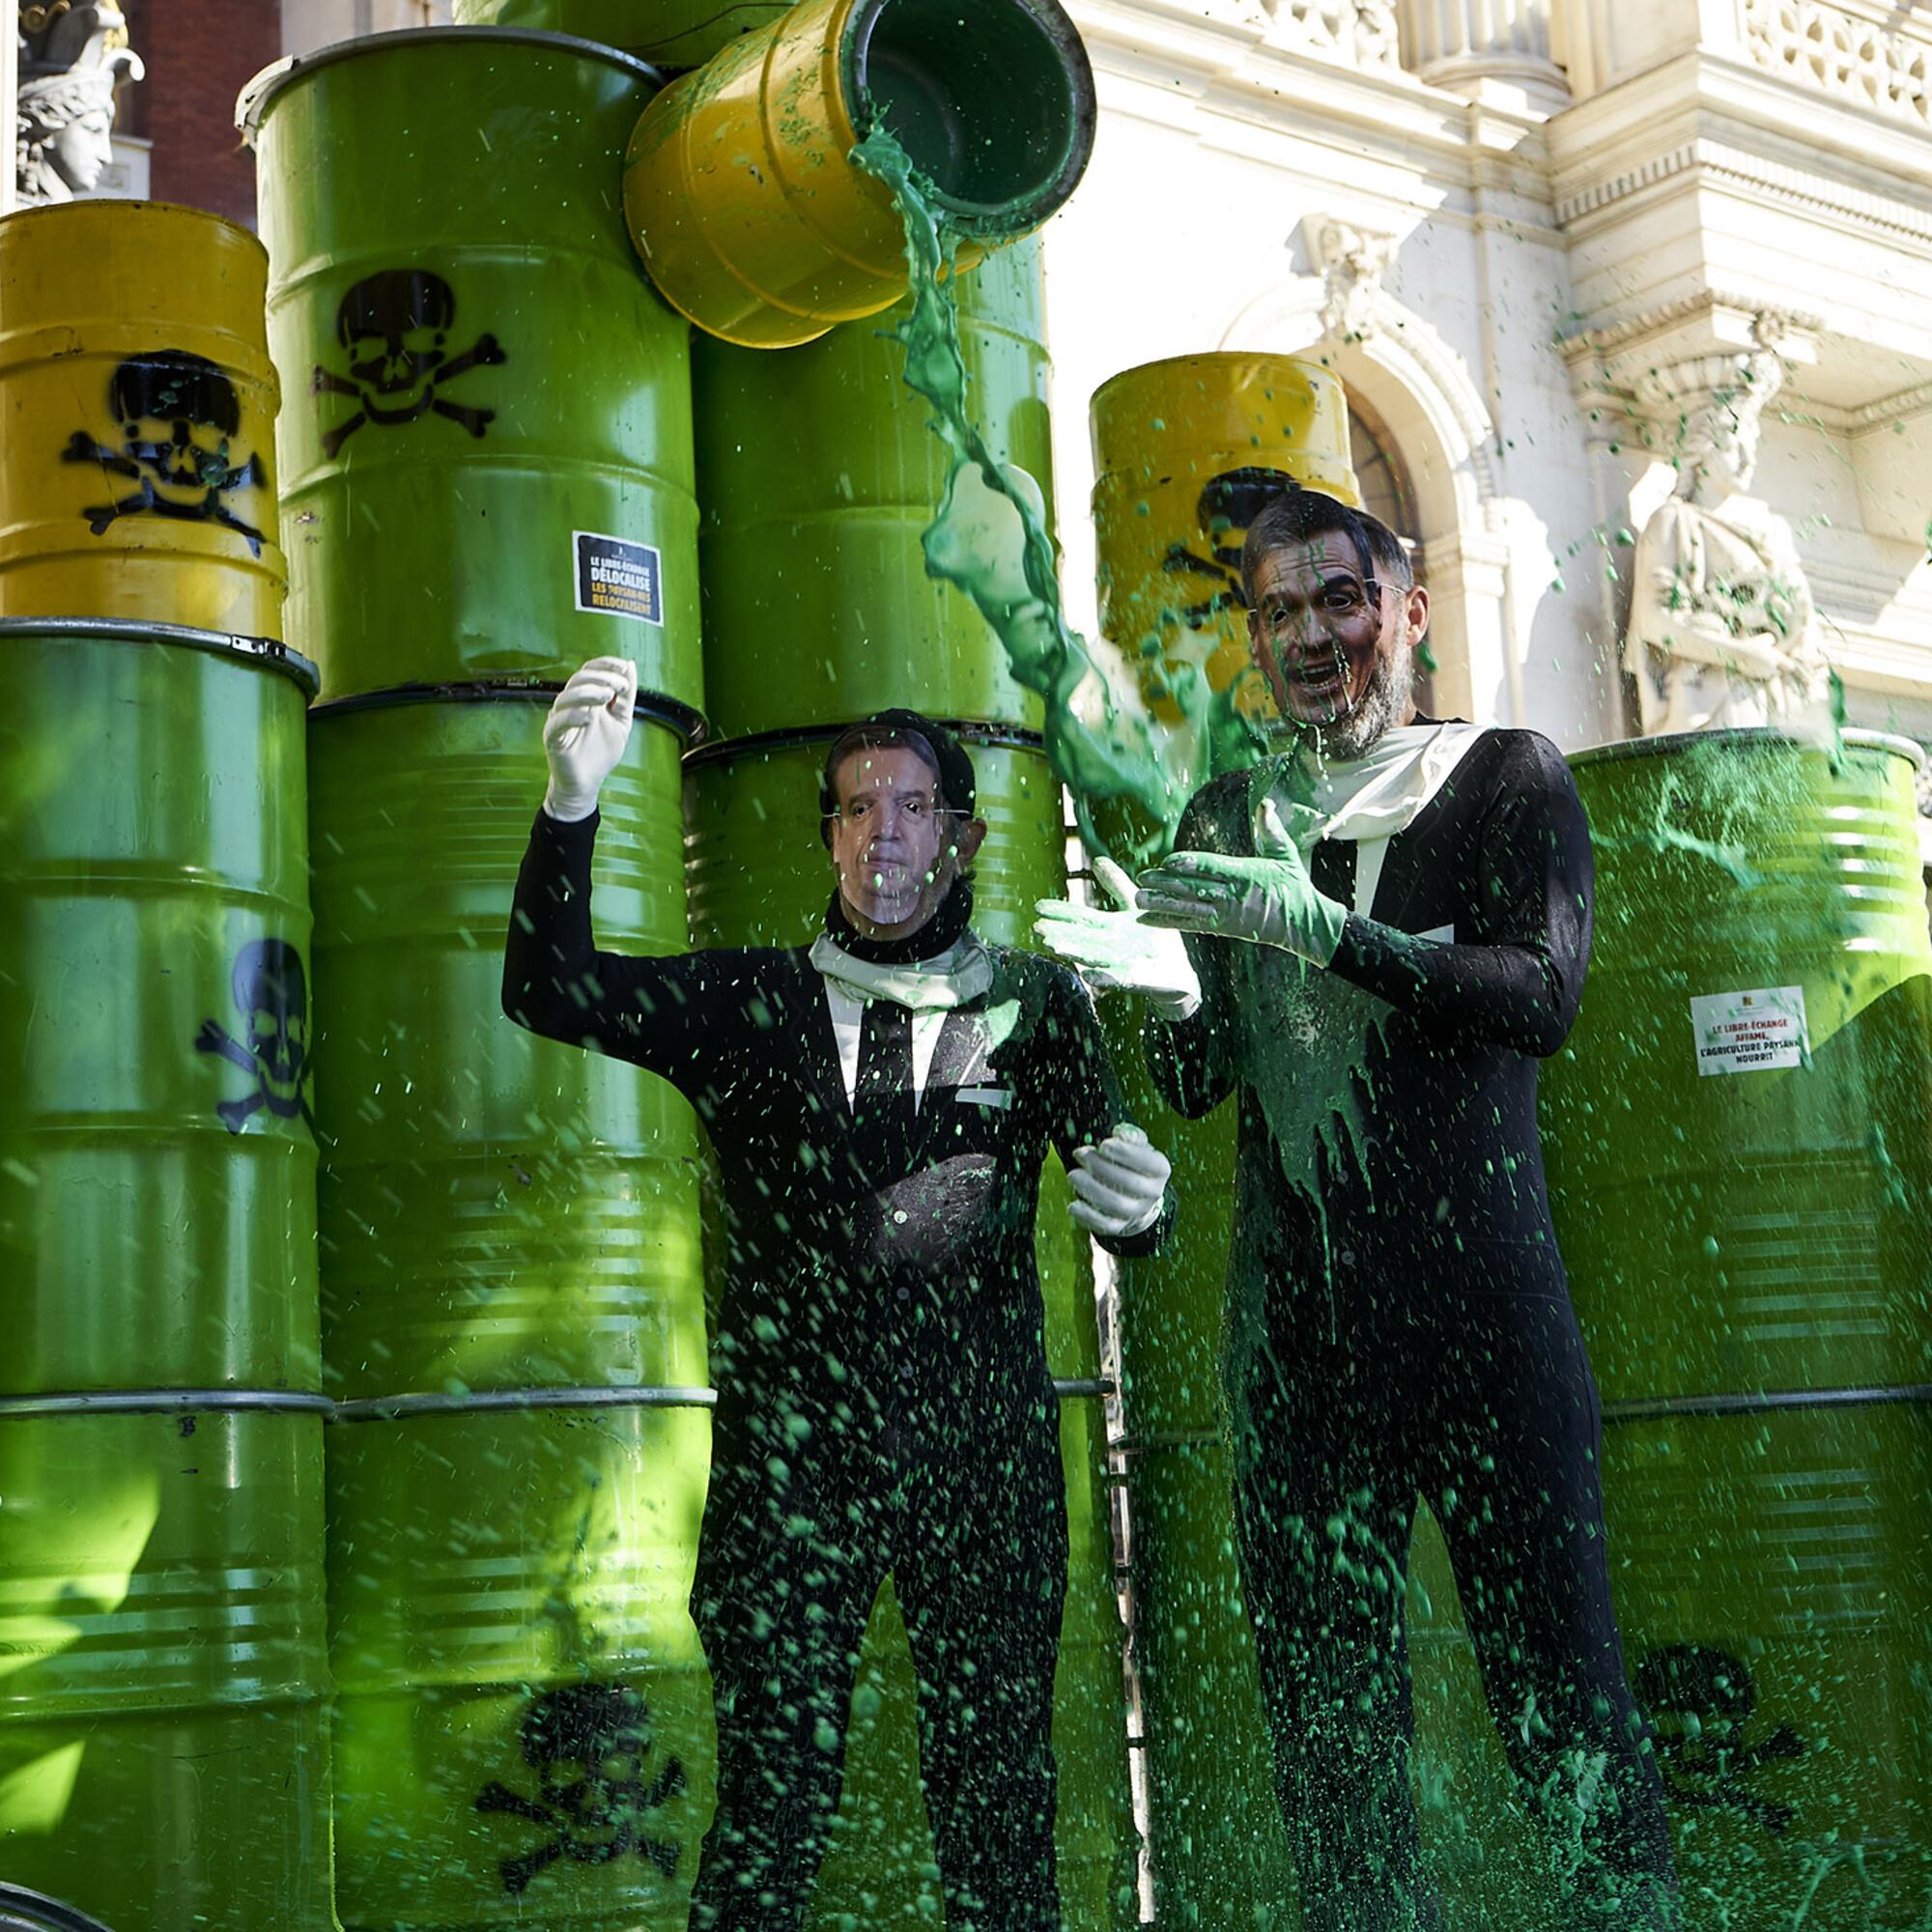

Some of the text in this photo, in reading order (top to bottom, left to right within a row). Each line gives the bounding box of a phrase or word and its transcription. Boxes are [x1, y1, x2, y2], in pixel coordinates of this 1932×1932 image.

[590, 556, 600, 566] LE
[590, 567, 651, 591] DÉLOCALISE
[591, 582, 607, 593] LES
[1712, 1019, 1788, 1035] LE LIBRE-ÉCHANGE
[1700, 1043, 1761, 1057] L'AGRICULTURE
[1736, 1053, 1774, 1064] NOURRIT
